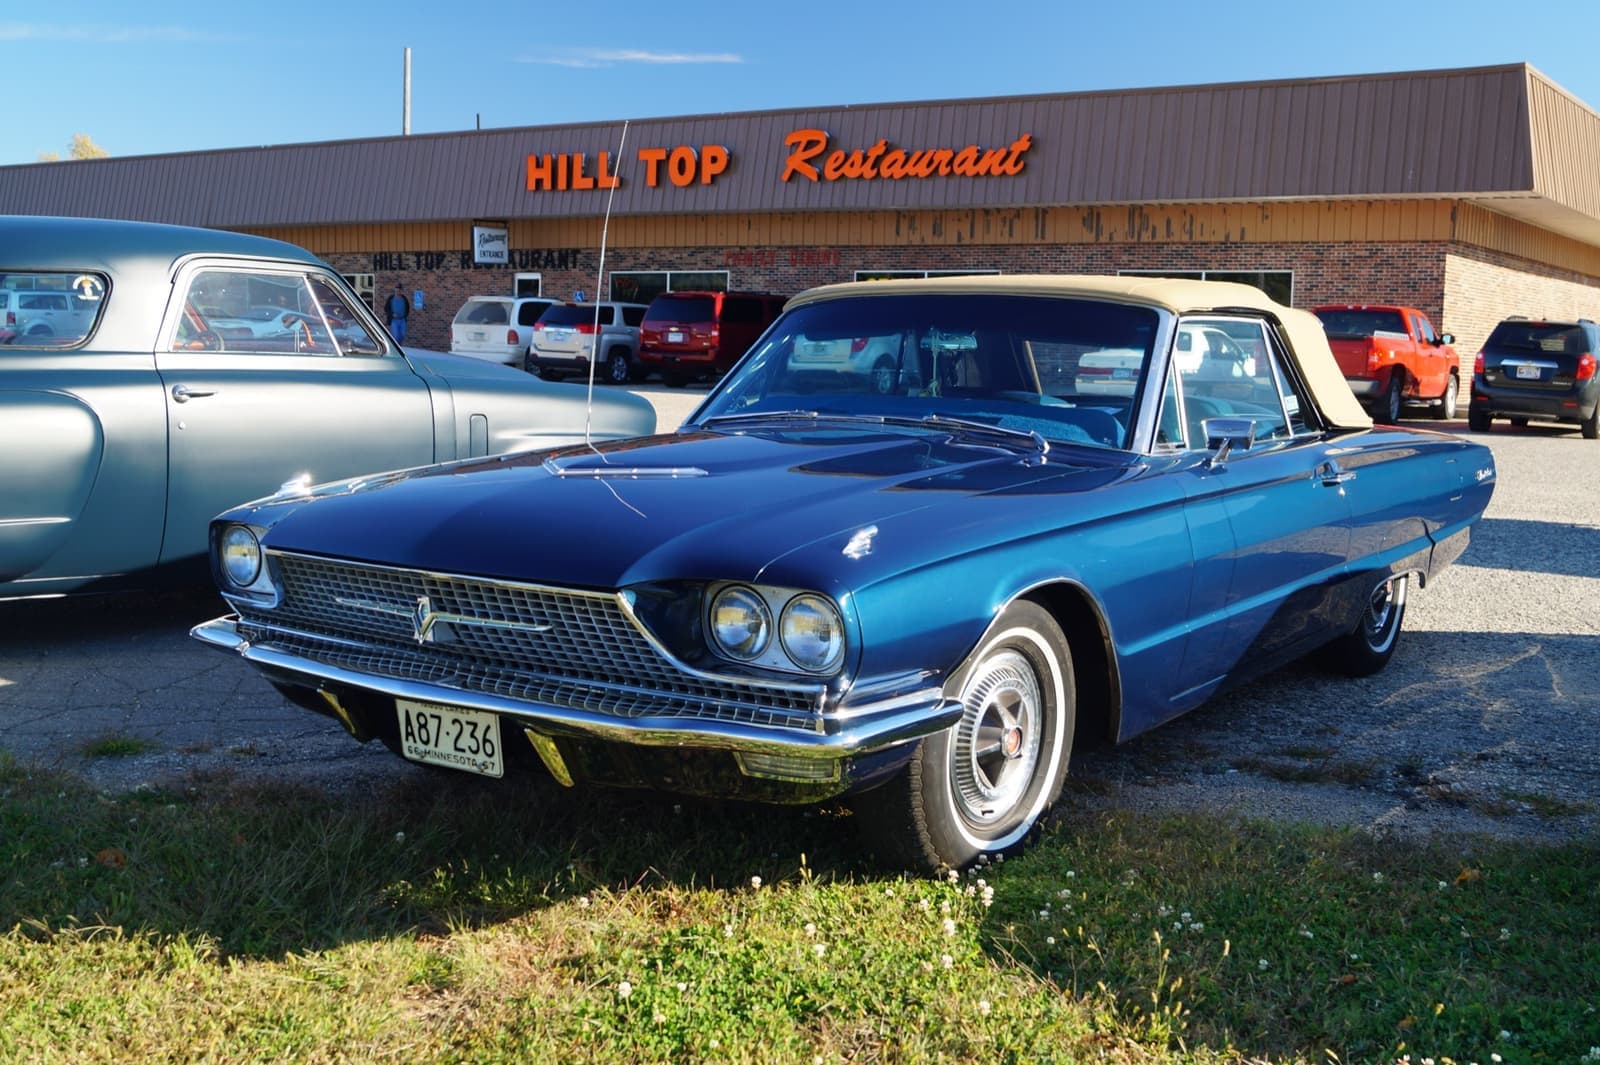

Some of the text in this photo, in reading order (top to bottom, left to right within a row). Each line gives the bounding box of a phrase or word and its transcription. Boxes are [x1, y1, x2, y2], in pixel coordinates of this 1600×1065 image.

[526, 128, 1033, 192] HILL TOP Restaurant
[373, 250, 580, 271] HILL TOP RAURANT
[479, 250, 505, 259] ENTRANCE
[423, 748, 479, 767] MINNESOTA
